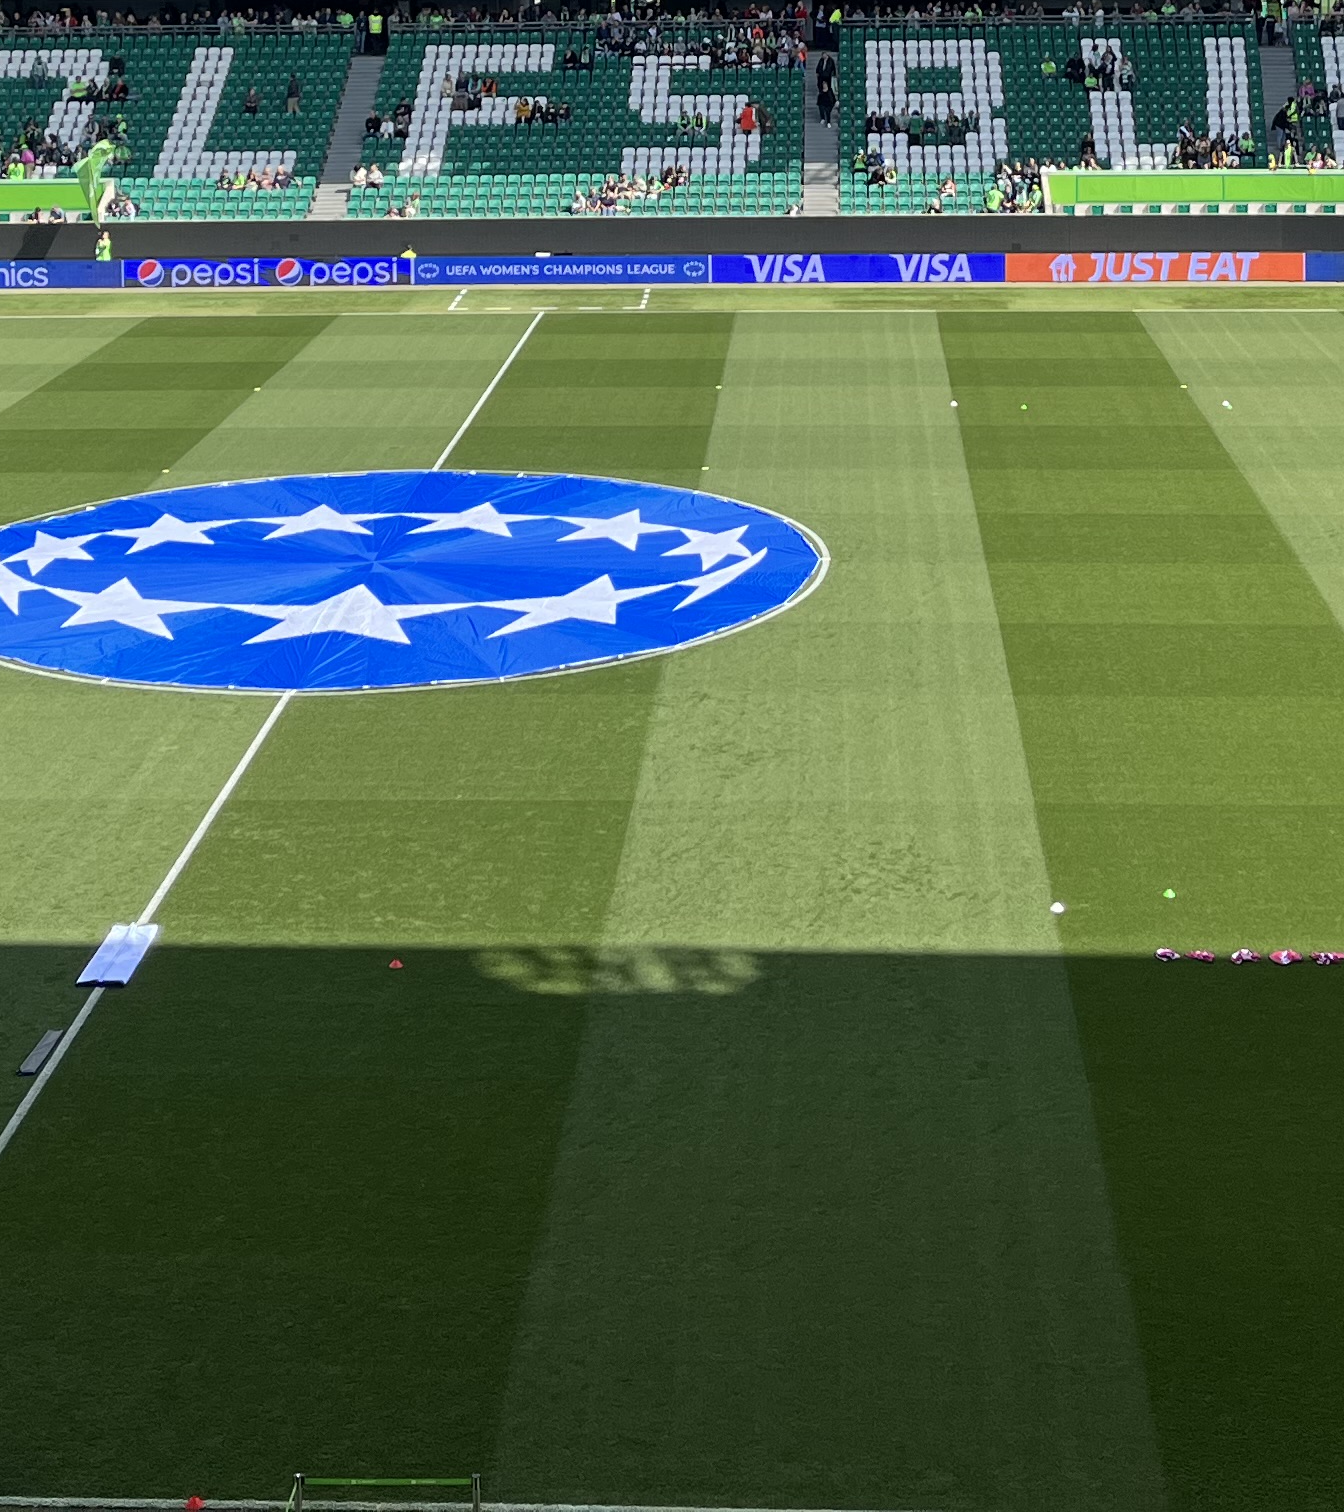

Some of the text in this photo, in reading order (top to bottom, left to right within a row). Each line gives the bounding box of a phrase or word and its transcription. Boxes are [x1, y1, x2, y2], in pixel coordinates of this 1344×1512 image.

[171, 258, 259, 287] pepsi
[310, 257, 398, 286] pepsi
[446, 263, 675, 276] UEFA WOMEN'S CHAMPIONS LEAGUE
[744, 254, 826, 282] VISA
[889, 253, 972, 282] VISA
[1088, 251, 1260, 282] JUST EAT
